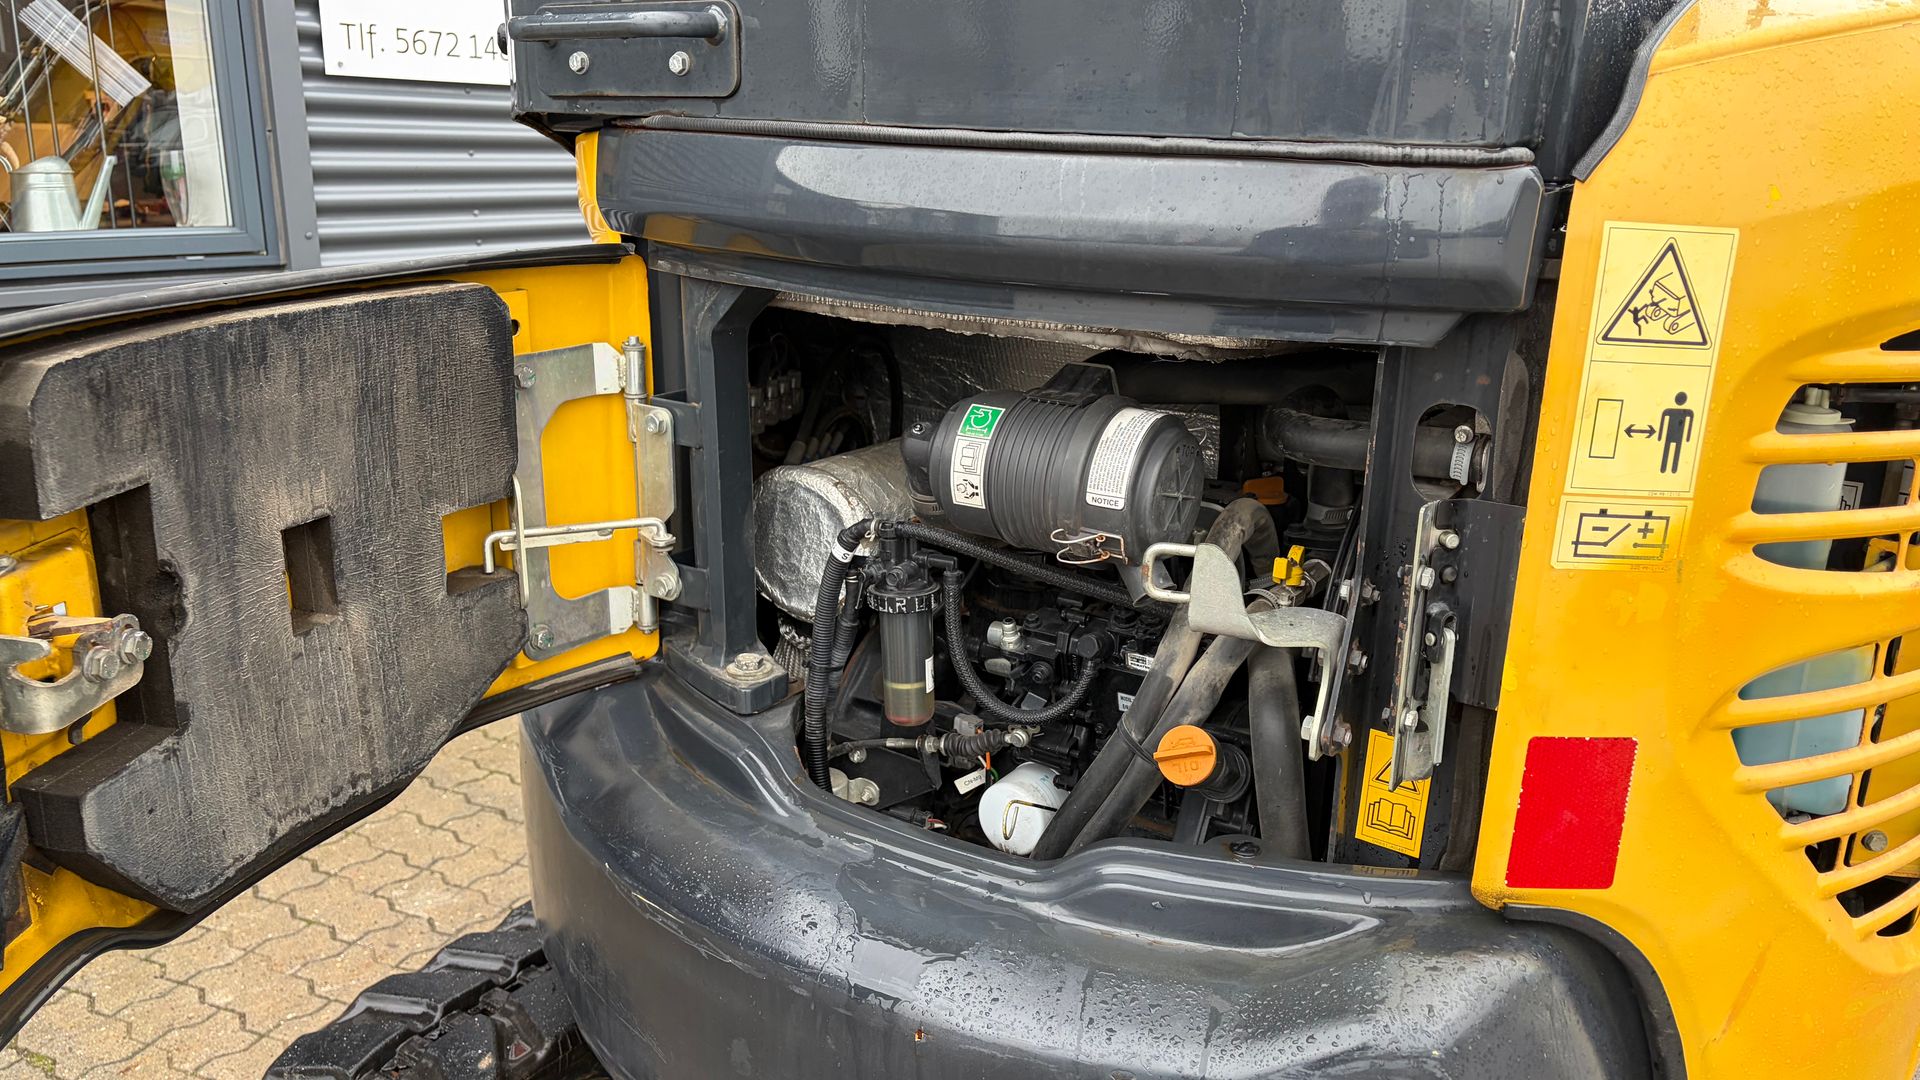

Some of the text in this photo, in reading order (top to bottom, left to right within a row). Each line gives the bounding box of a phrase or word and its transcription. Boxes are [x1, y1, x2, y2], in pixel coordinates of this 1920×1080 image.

[339, 22, 508, 61] Tlf. 5672 14
[1091, 496, 1119, 507] NOTICE
[1172, 761, 1200, 773] OIL
